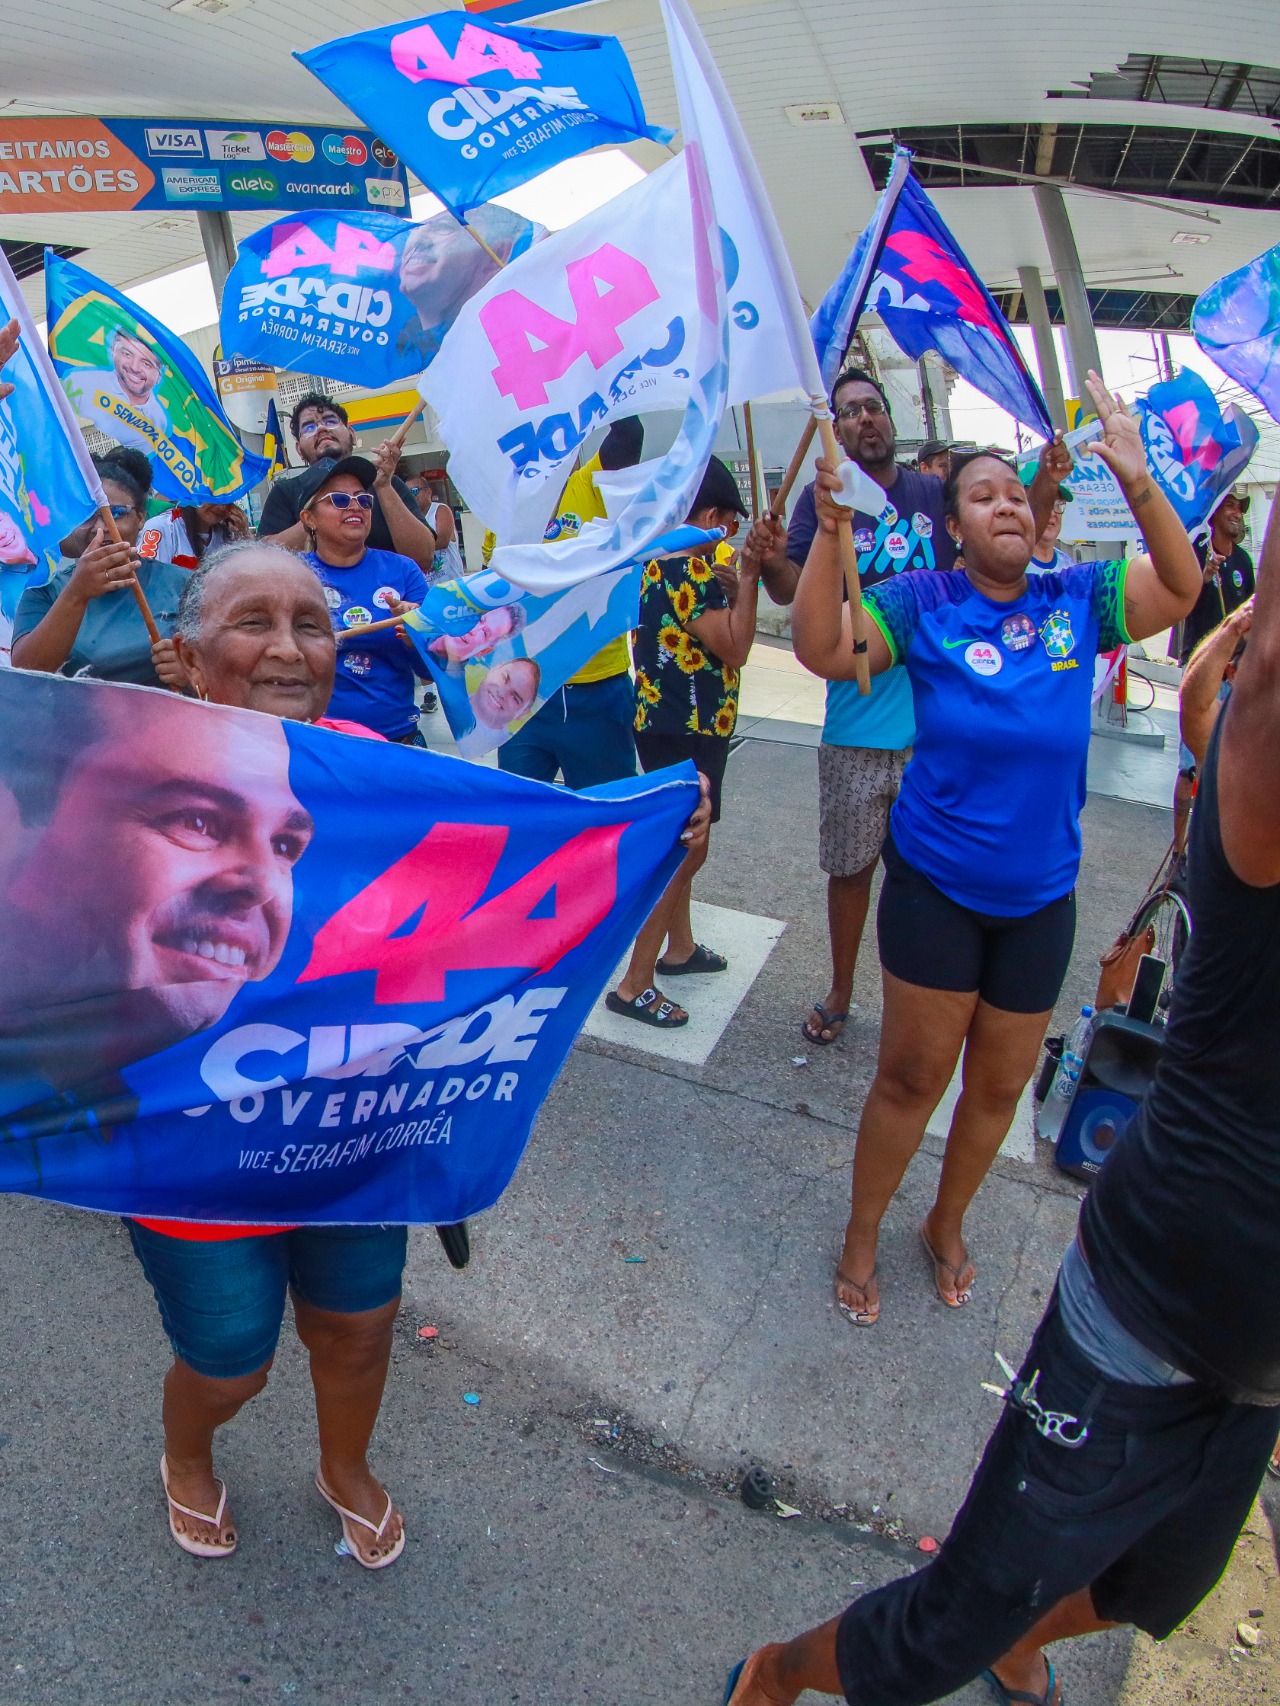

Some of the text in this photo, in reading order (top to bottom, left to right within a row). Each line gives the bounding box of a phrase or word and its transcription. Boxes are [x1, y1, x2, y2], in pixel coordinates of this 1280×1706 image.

[155, 133, 197, 148] VISA
[502, 147, 518, 160] VICE
[516, 117, 566, 154] SERAFIM
[222, 144, 251, 154] Ticket
[268, 140, 313, 152] MasterCard
[328, 144, 362, 156] Maestro
[166, 176, 216, 185] AMERICAN
[230, 177, 274, 192] alelo
[179, 184, 221, 194] EXPRESS
[286, 182, 351, 196] avancard
[221, 374, 265, 392] G Original
[99, 394, 110, 409] O
[113, 403, 159, 443] SENADOR
[156, 440, 175, 462] DO
[346, 613, 369, 622] WL
[973, 648, 992, 659] 44
[1051, 659, 1079, 672] BRASIL
[297, 822, 633, 1007] 44
[182, 1072, 519, 1128] OVERNADOR
[238, 1110, 453, 1174] VICE SERAFIM CORRÊA
